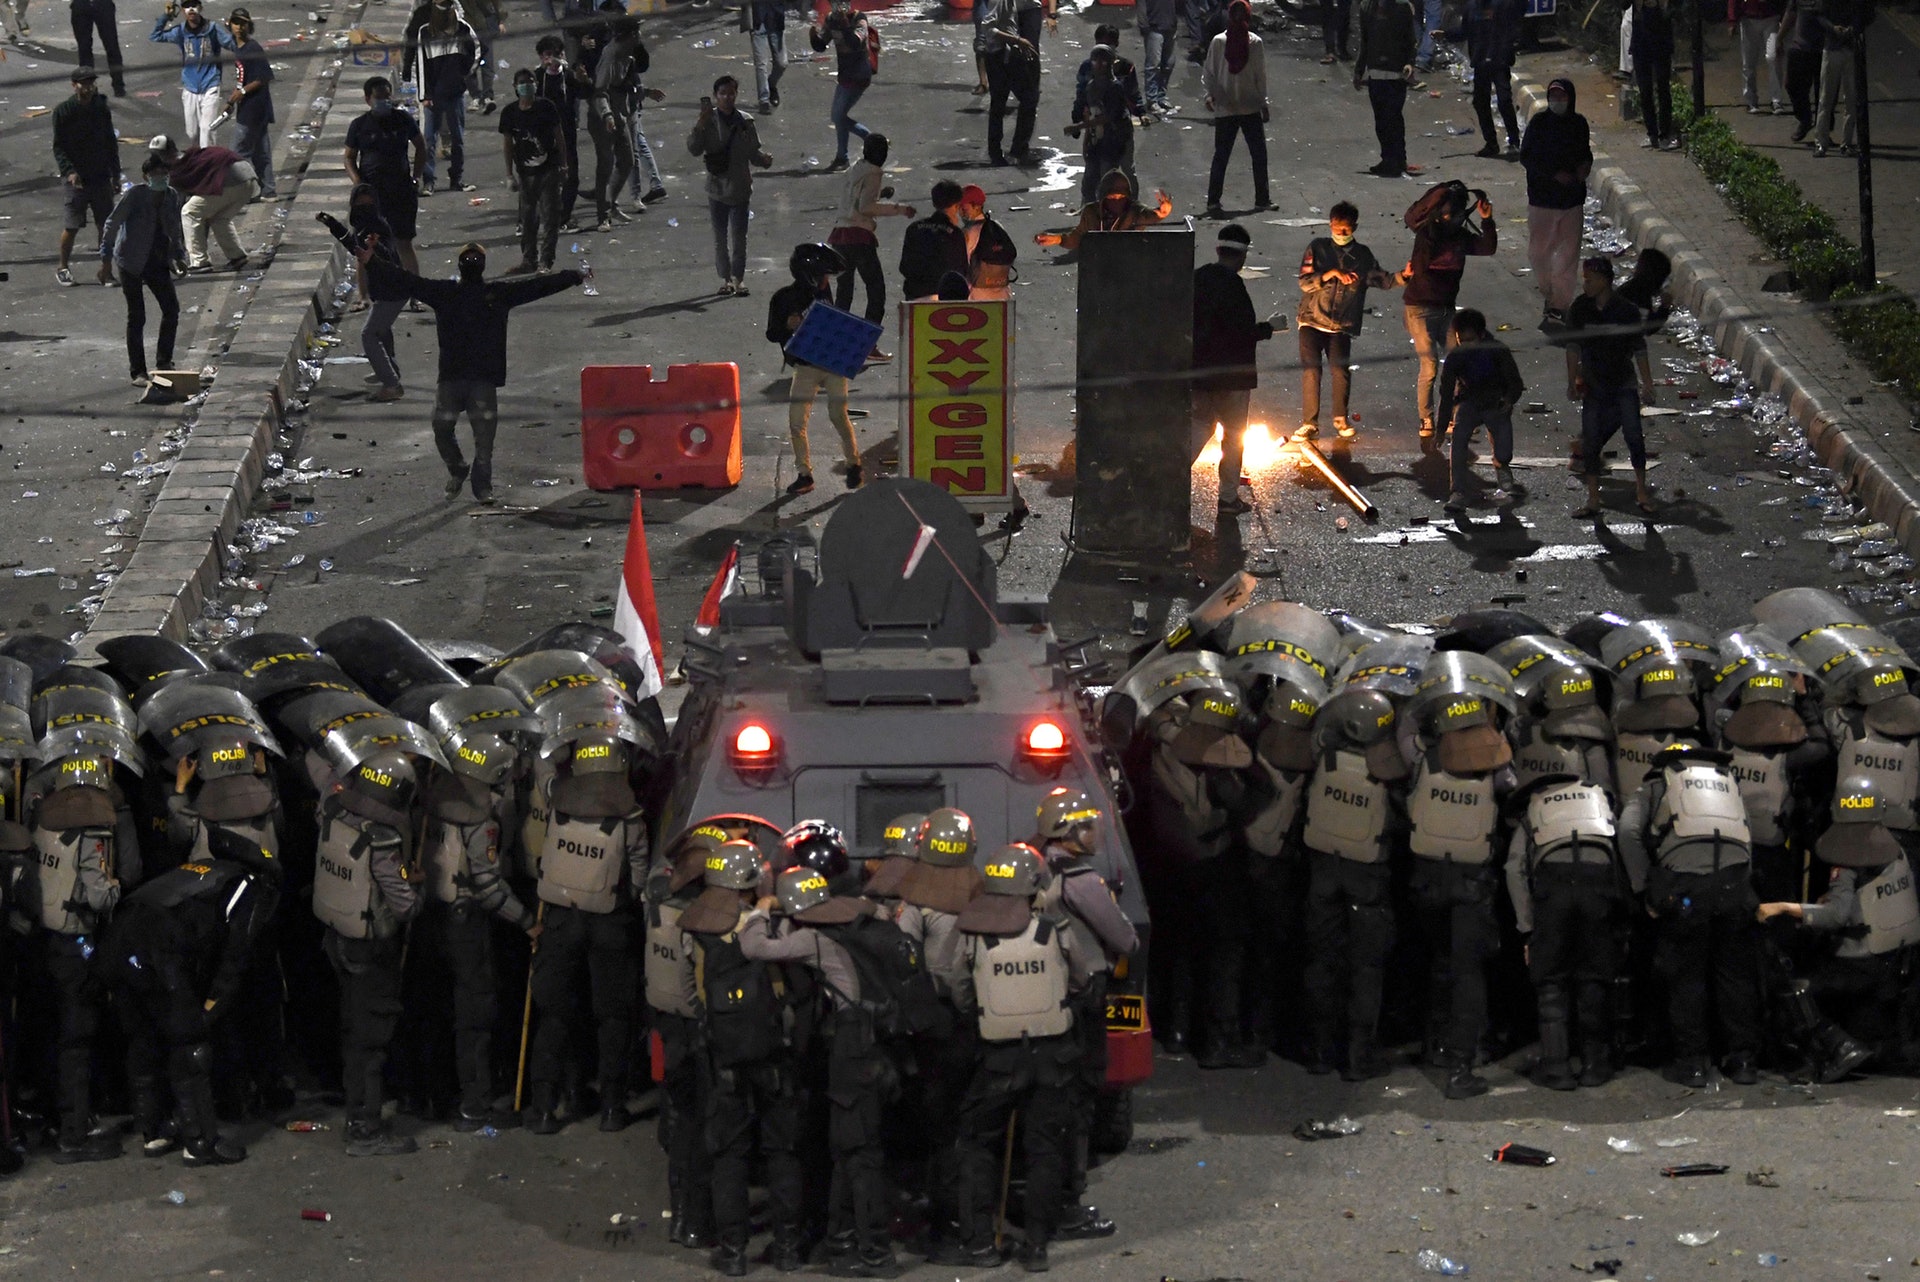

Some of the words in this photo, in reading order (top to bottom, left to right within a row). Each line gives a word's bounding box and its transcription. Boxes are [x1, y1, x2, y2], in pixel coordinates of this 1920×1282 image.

[927, 306, 990, 492] OXYGEN
[1238, 640, 1327, 679] POLISI
[1618, 640, 1710, 670] POISI
[243, 652, 314, 678] OLISI
[1713, 652, 1806, 683] POISI
[1415, 673, 1507, 695] POISI
[1643, 669, 1676, 685] POLISI
[1748, 675, 1784, 689] POLISI
[1873, 668, 1905, 687] POLIS
[1561, 679, 1594, 695] POLISI
[1289, 700, 1317, 718] POLI
[1446, 700, 1482, 718] POLISI
[320, 711, 392, 738] LISI
[439, 709, 521, 746] POLII
[211, 748, 246, 763] POLISI
[576, 745, 610, 760] POLISI
[1619, 748, 1653, 764] POLIS
[62, 759, 98, 774] POLISI
[1521, 759, 1566, 773] POLISI
[1854, 753, 1902, 771] POLISI
[1730, 765, 1767, 784] OLISI
[1684, 779, 1730, 793] POLISI
[1324, 785, 1370, 808] POLISI
[1430, 787, 1479, 806] POLISI
[1840, 796, 1875, 809] POLISI
[691, 825, 729, 843] POLISI
[884, 827, 906, 840] LISI
[557, 837, 606, 860] POLISI
[930, 838, 967, 854] POLISI
[36, 852, 60, 869] LISI
[320, 856, 353, 881] POLISI
[705, 857, 726, 871] LISI
[800, 876, 829, 893] POLI
[1876, 874, 1909, 899] POLISI
[653, 942, 677, 961] POL
[993, 960, 1046, 976] POLISI
